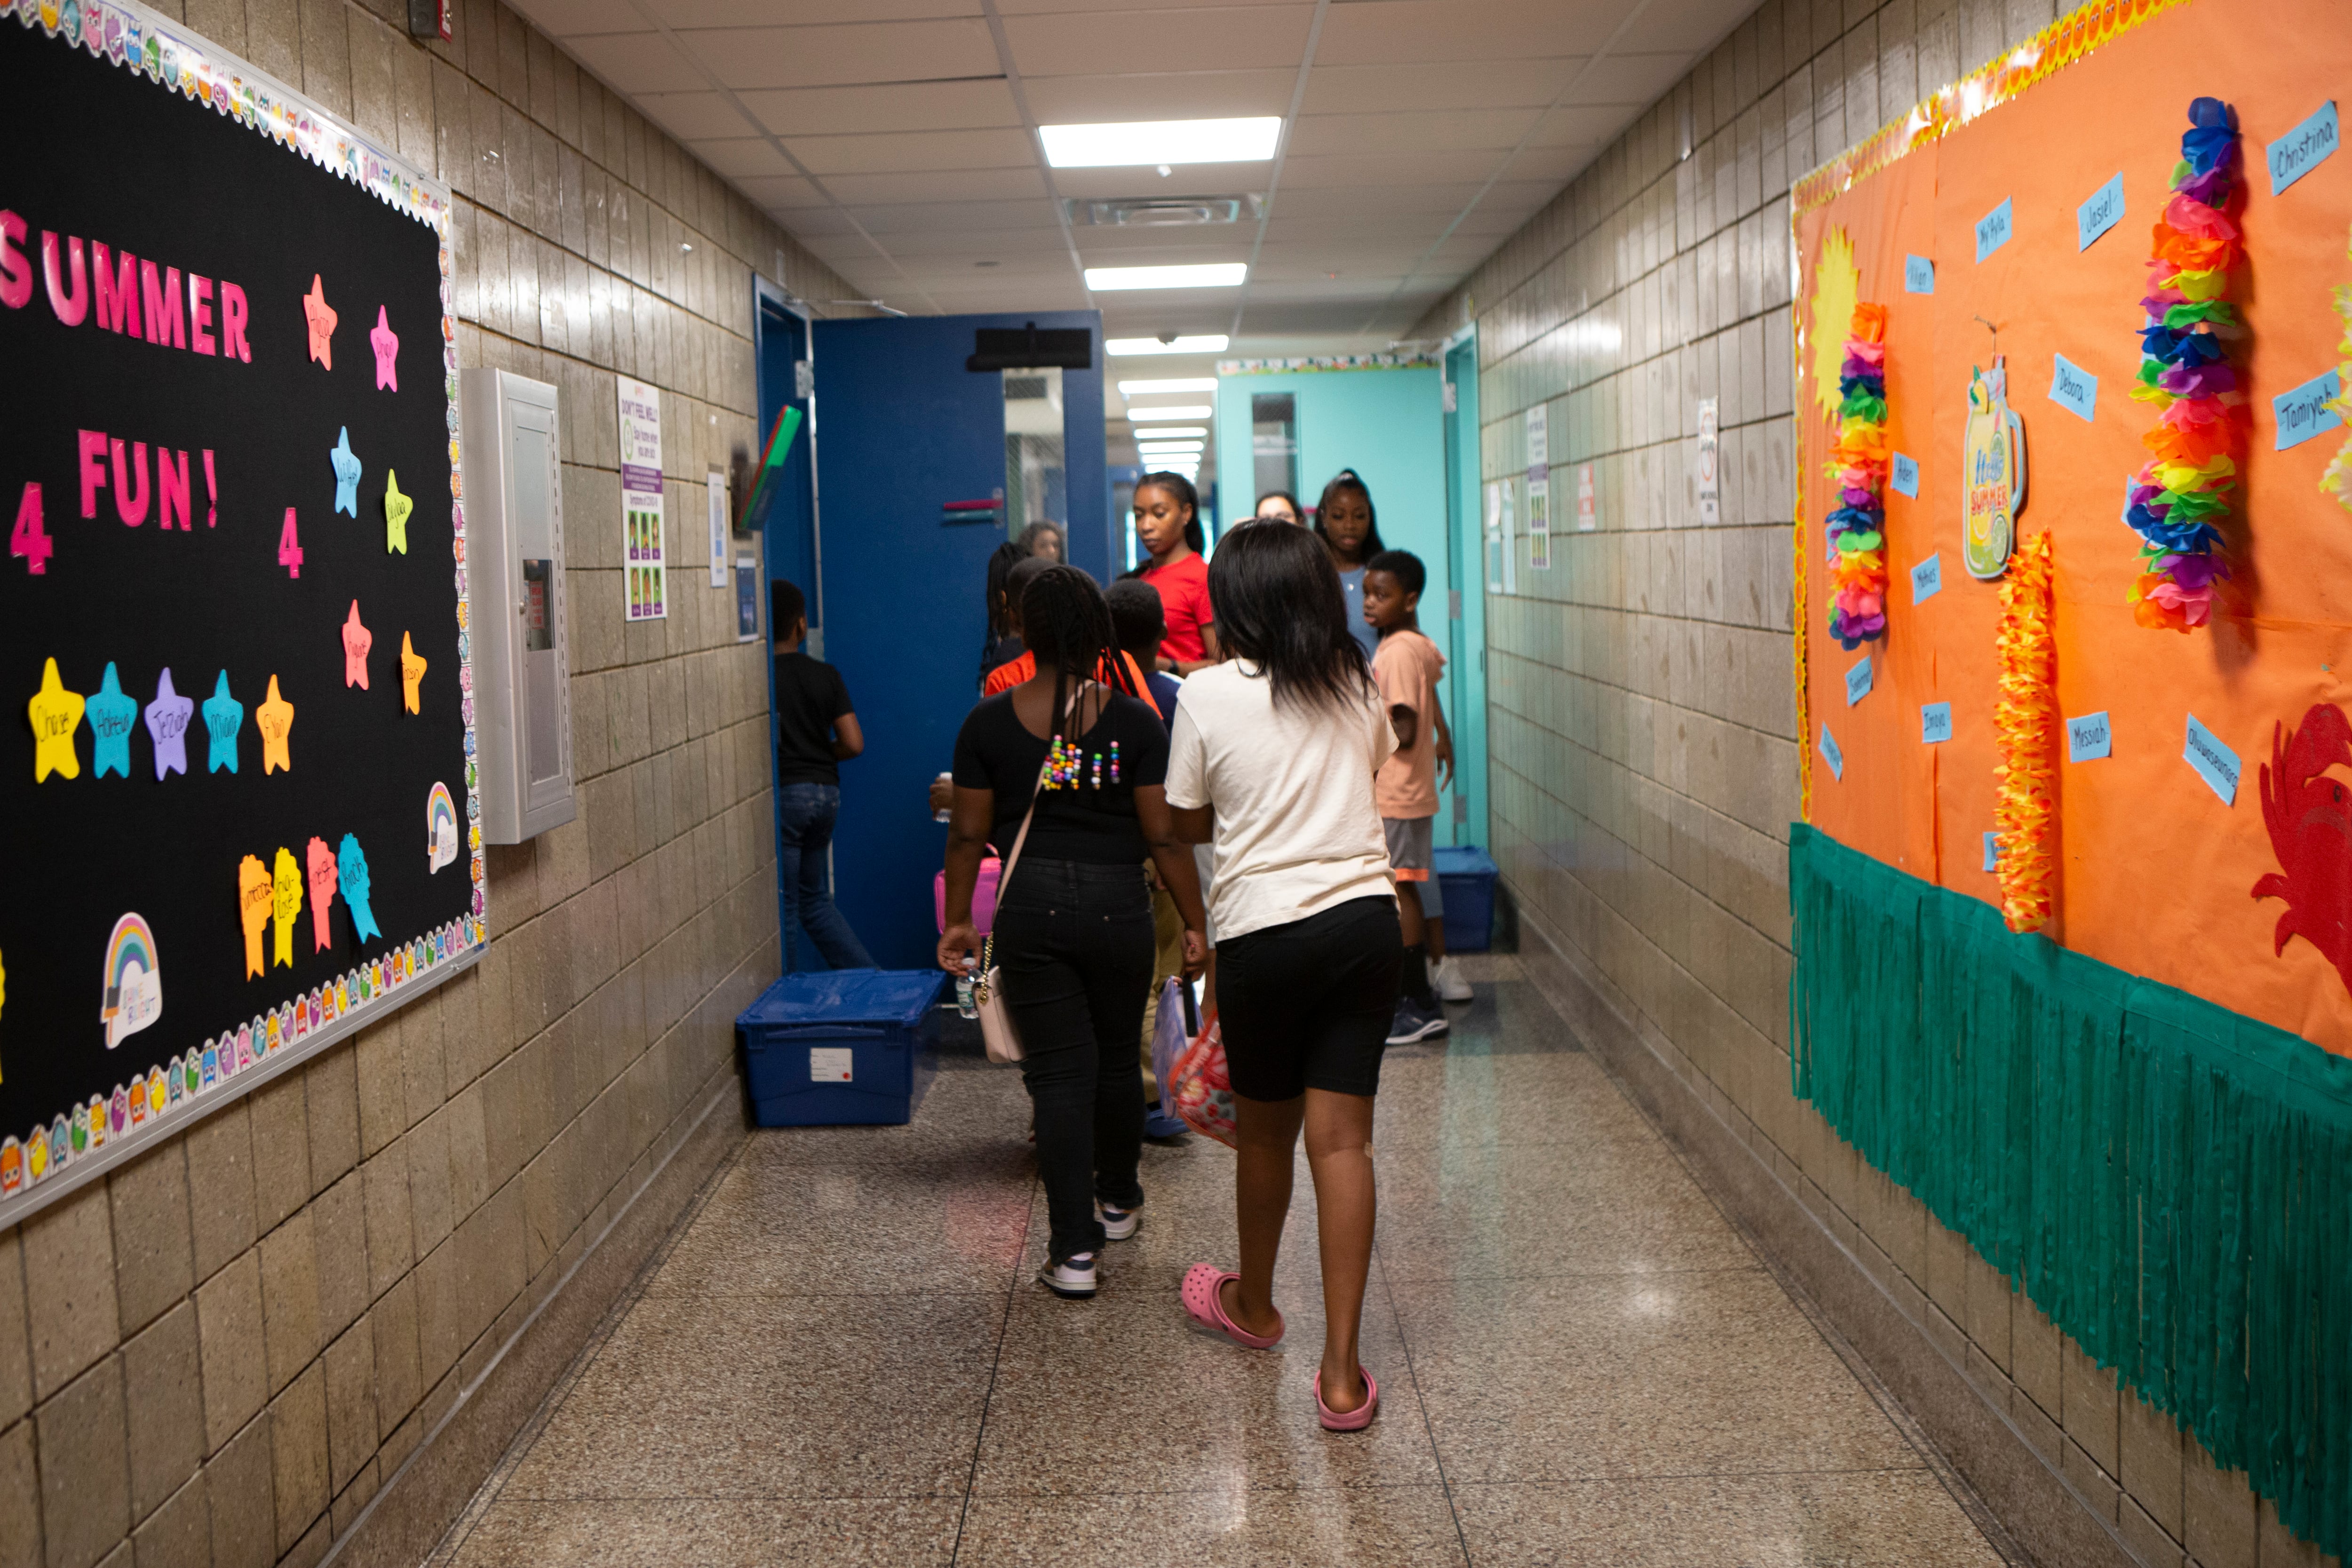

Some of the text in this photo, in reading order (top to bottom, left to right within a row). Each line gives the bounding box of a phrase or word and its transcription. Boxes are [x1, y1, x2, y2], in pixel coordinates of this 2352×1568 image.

[2278, 121, 2333, 178] Christina
[0, 209, 252, 363] SUMMER
[2059, 367, 2084, 404] Debora
[78, 429, 217, 532] FUN!
[1971, 485, 2008, 515] SUMMER
[10, 482, 54, 575] 4
[278, 507, 304, 579] 4
[2073, 719, 2106, 751] Messiah
